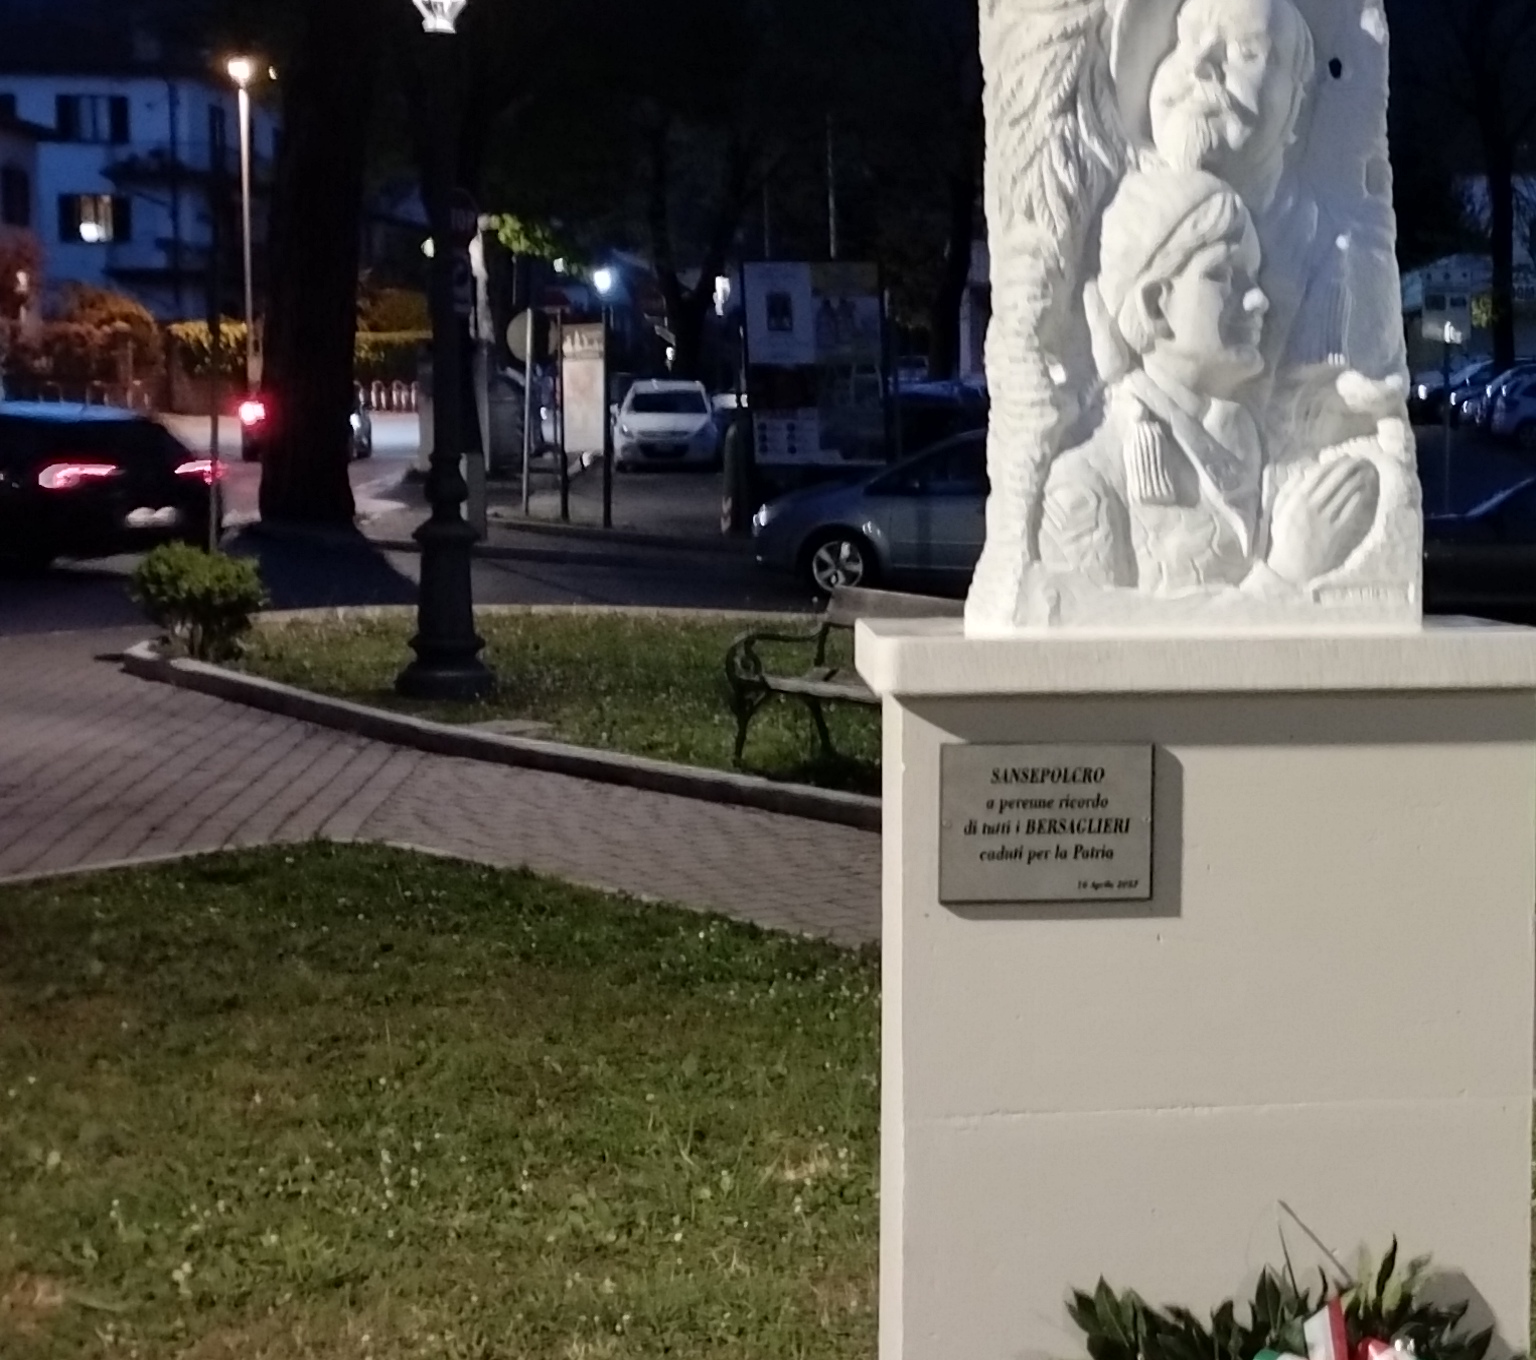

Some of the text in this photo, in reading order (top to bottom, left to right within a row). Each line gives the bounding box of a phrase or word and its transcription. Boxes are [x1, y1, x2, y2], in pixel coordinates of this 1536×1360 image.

[990, 766, 1106, 785] SANSEPOLCRO
[986, 793, 1109, 815] a perenne ricordo
[963, 817, 1131, 836] di tutti i BERSAGLIERI
[979, 844, 1114, 865] caduti per la Patria
